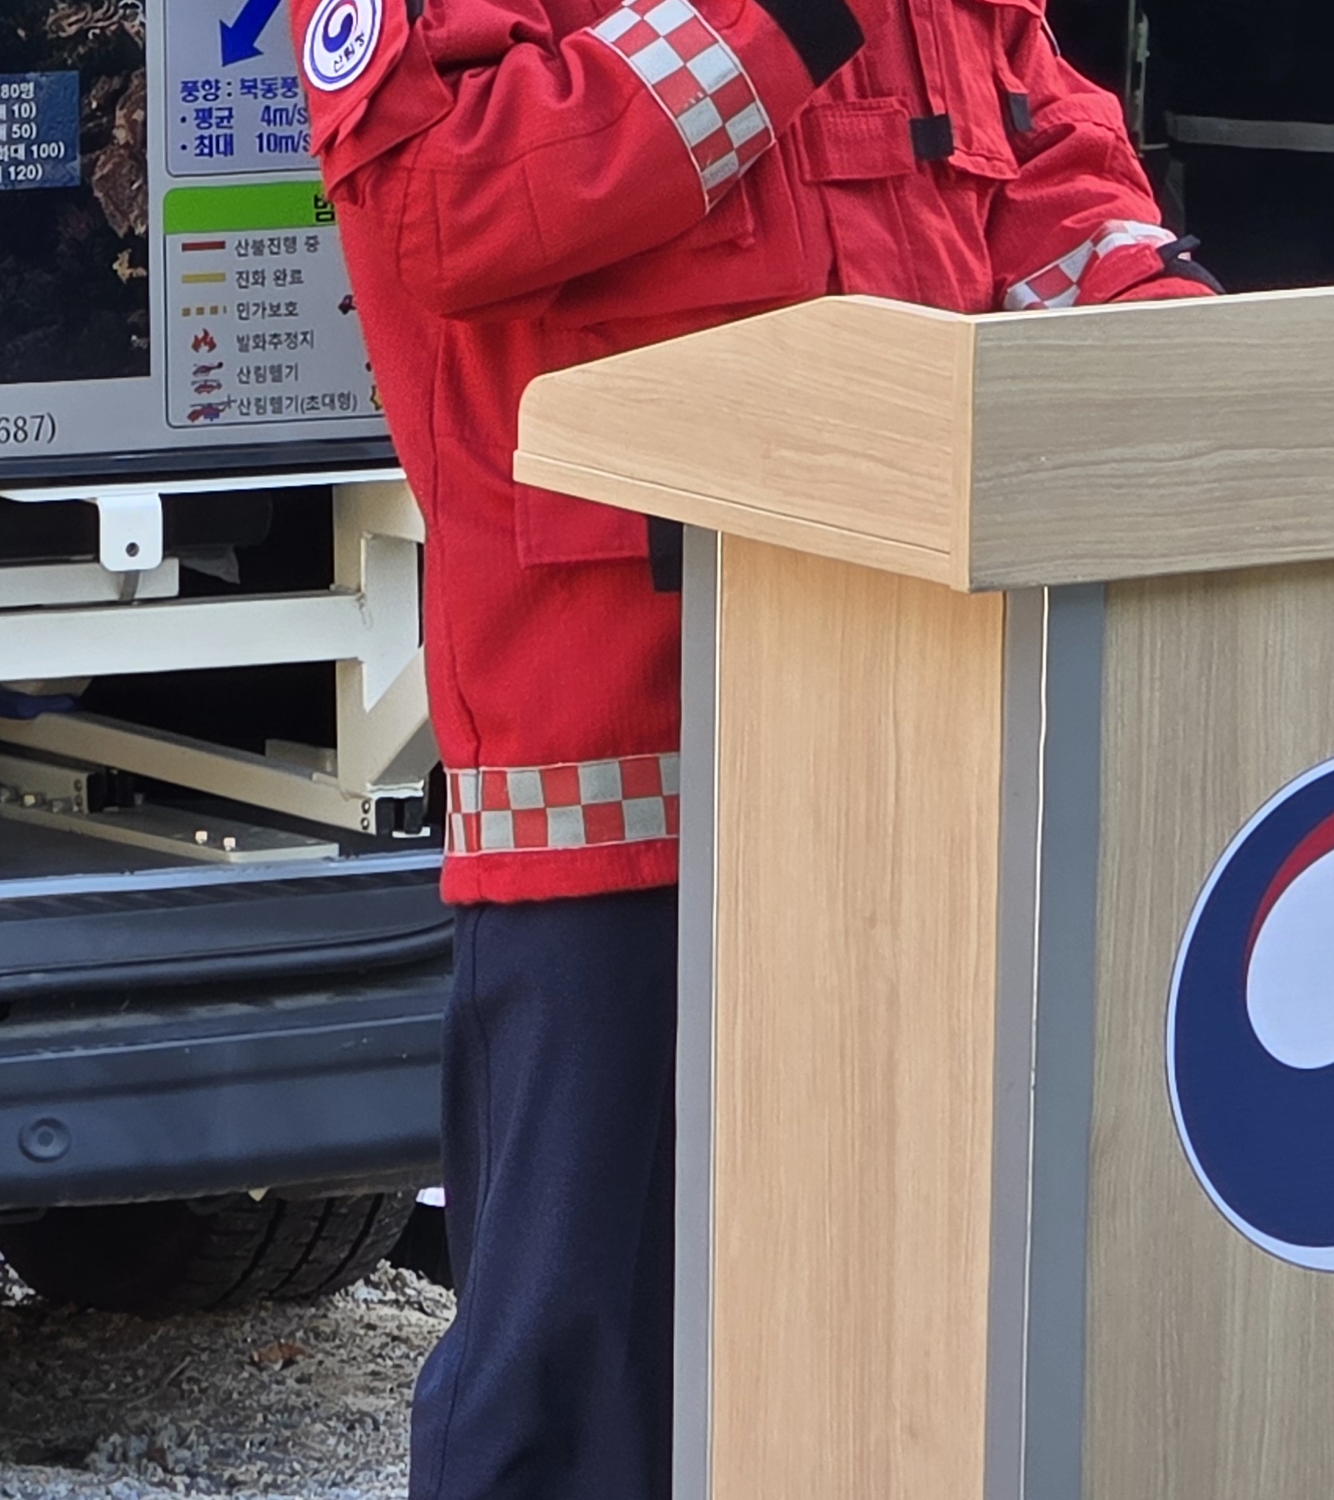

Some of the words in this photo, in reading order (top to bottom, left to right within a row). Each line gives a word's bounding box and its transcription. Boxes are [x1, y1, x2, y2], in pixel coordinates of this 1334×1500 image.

[180, 79, 222, 103] 풍향
[11, 101, 37, 120] 10)
[194, 106, 234, 130] 평균
[11, 122, 37, 141] 50)
[31, 141, 65, 160] 100)
[194, 133, 234, 157] 최대
[8, 163, 43, 182] 120)
[235, 237, 298, 258] 산불진행
[304, 235, 320, 253] 중
[235, 268, 266, 288] 진화
[273, 267, 304, 287] 완료
[236, 329, 315, 351] 발화추정지
[236, 363, 299, 385] 산림헬기
